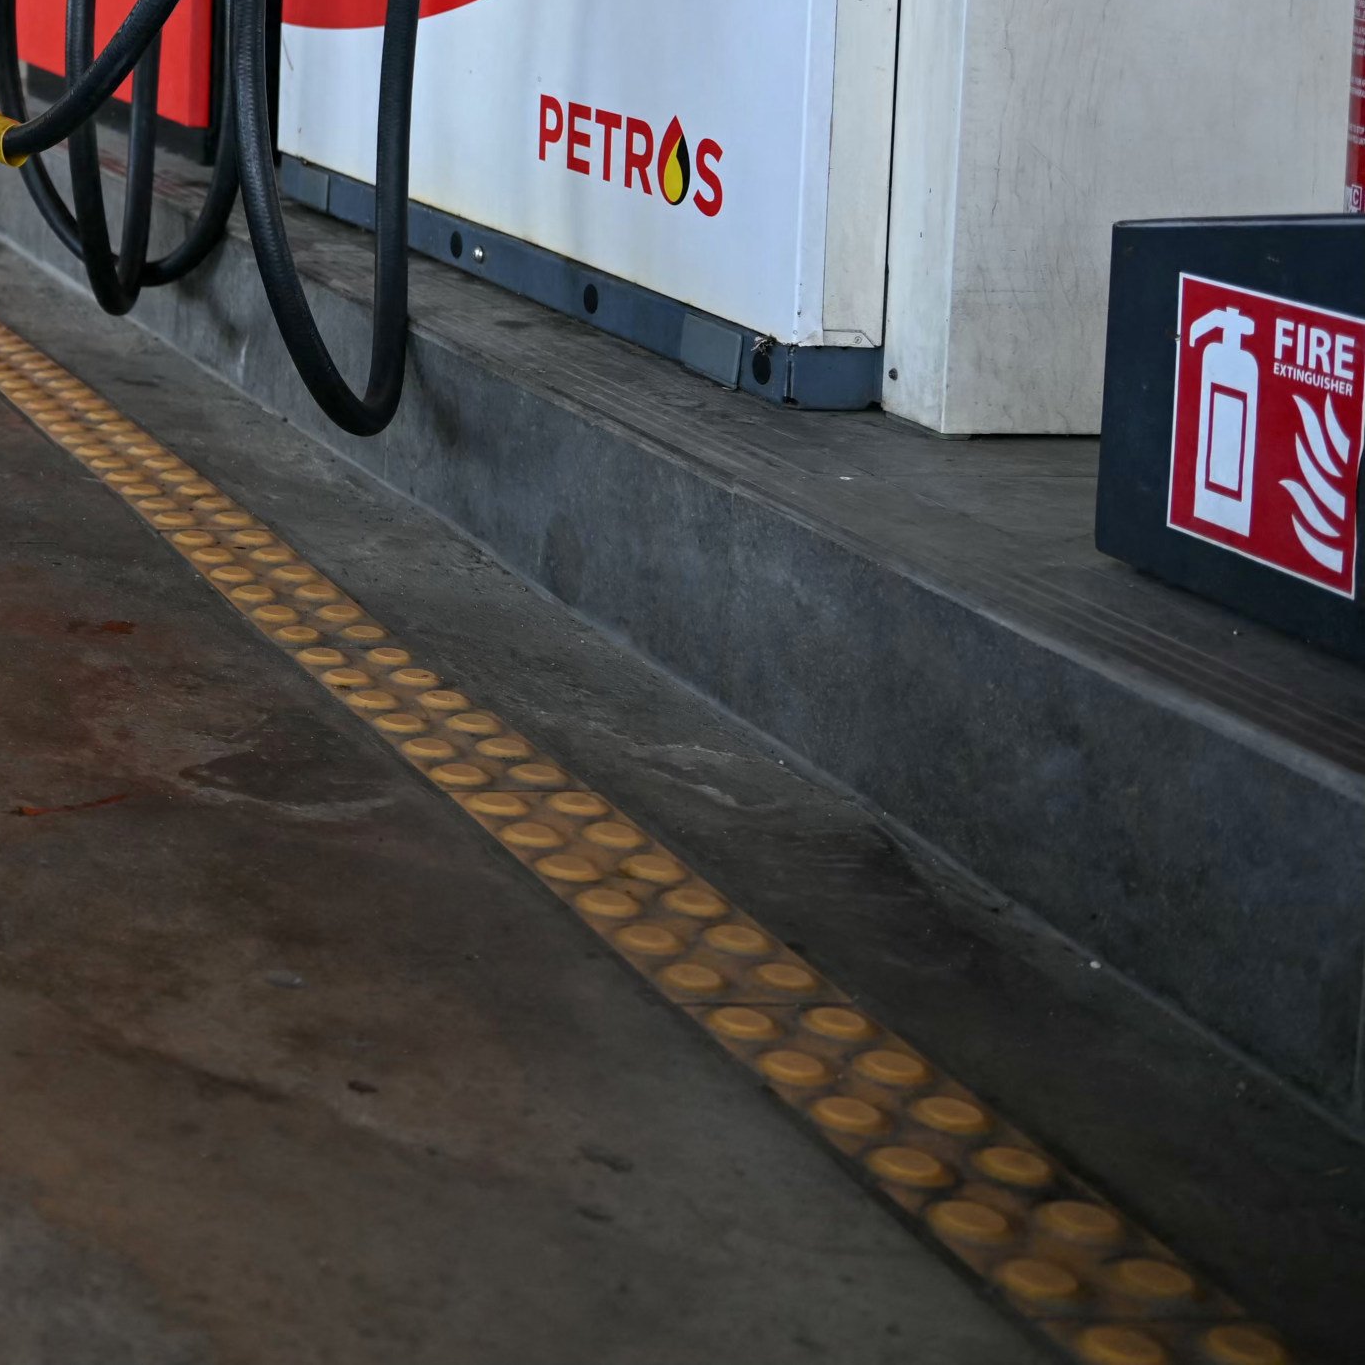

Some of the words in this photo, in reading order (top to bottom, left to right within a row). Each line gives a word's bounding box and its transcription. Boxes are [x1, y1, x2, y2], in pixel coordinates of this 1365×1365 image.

[538, 93, 723, 217] PETROS
[1273, 362, 1353, 397] EXTINGUISHER
[1274, 318, 1355, 381] FIRE
